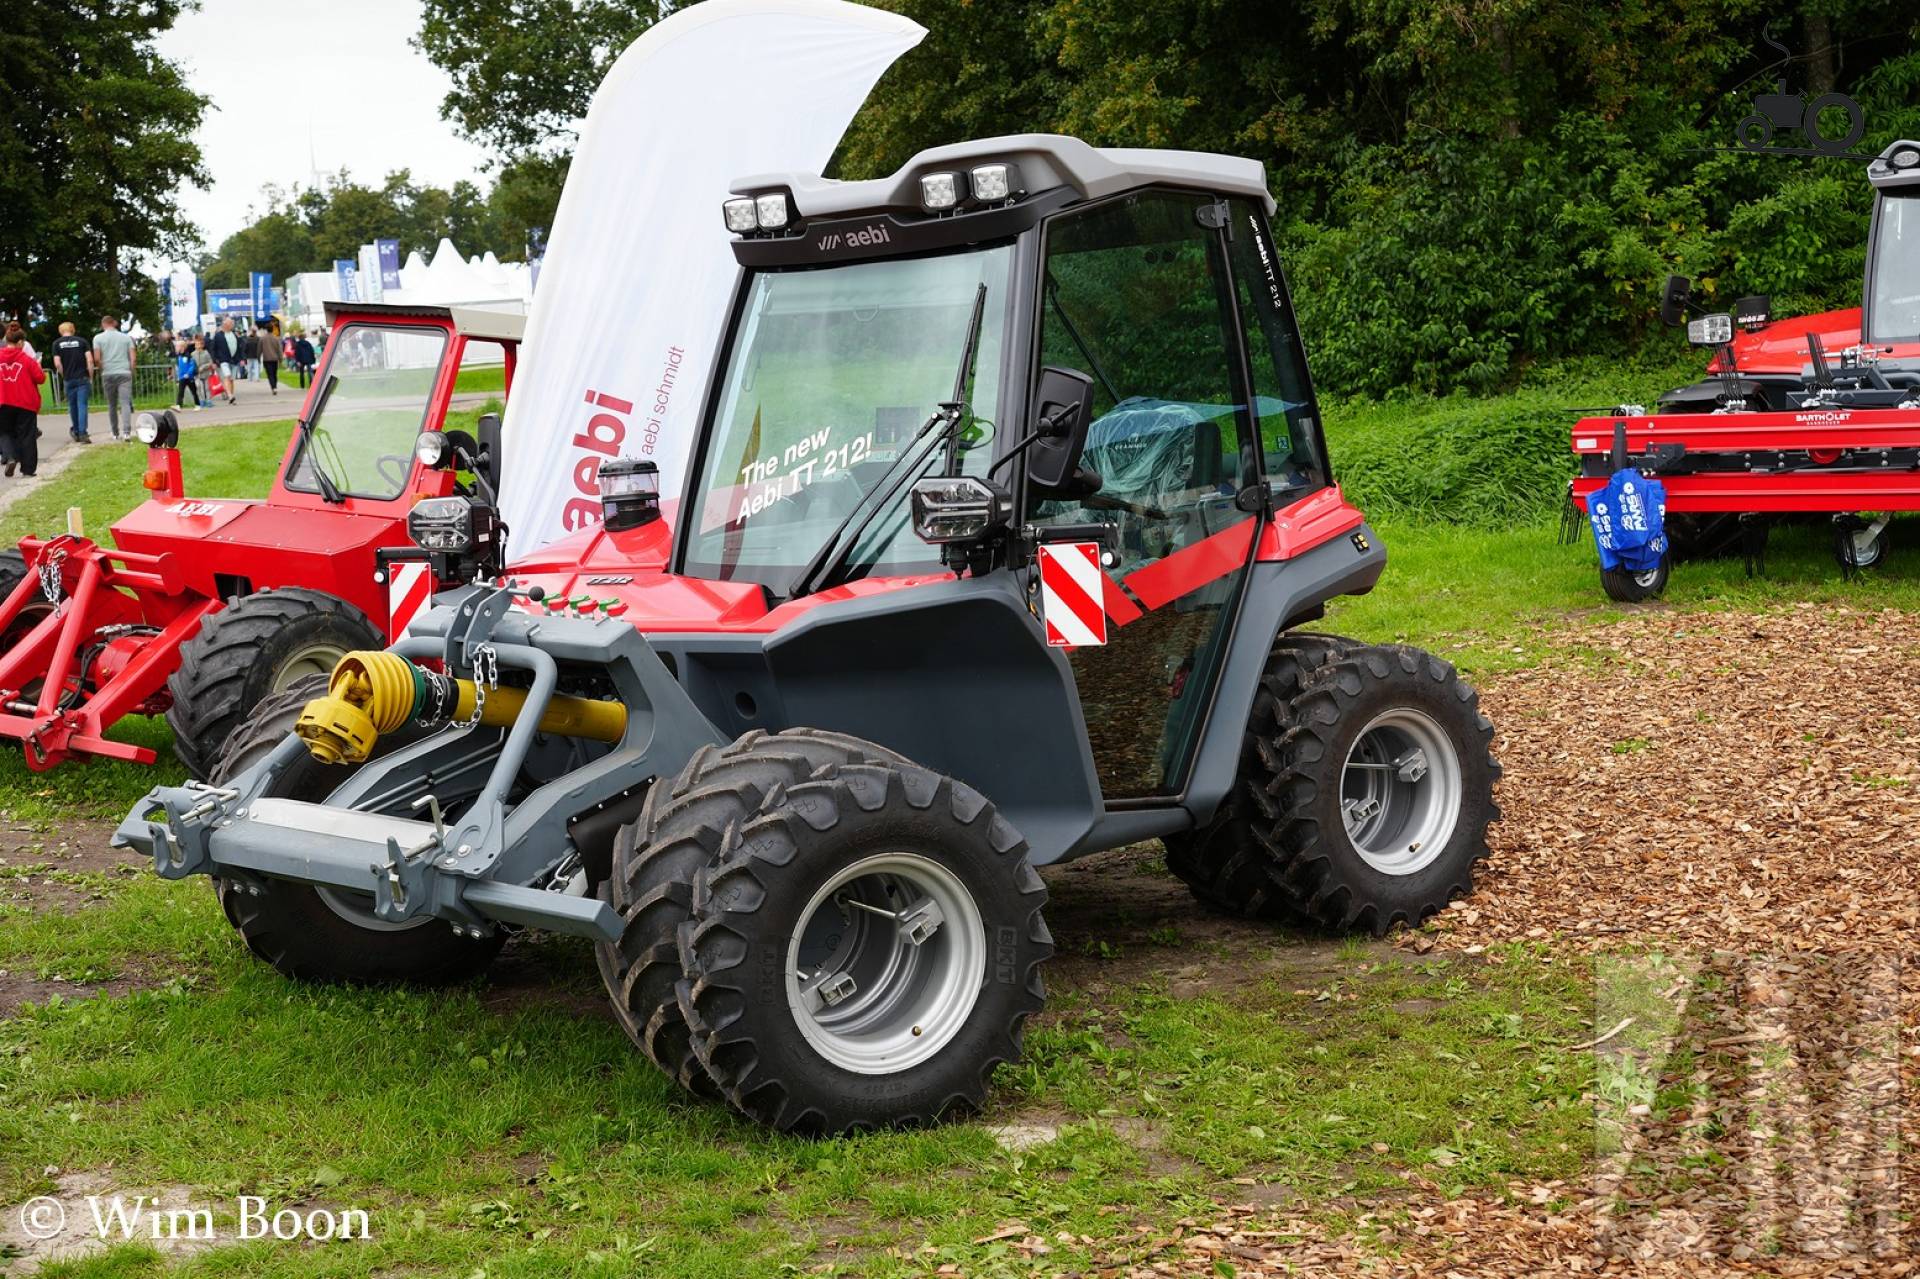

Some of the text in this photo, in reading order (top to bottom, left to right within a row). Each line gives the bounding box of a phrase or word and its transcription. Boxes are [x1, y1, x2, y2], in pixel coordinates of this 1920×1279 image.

[845, 223, 891, 248] aebi
[1269, 284, 1281, 308] 212
[641, 344, 686, 456] aebi schmidt
[1795, 412, 1851, 422] BARTHOLET
[562, 388, 634, 534] aebi
[735, 431, 874, 525] Aebi TT 212!
[739, 426, 831, 491] The new
[164, 501, 225, 517] AEBI
[997, 925, 1017, 985] BKT
